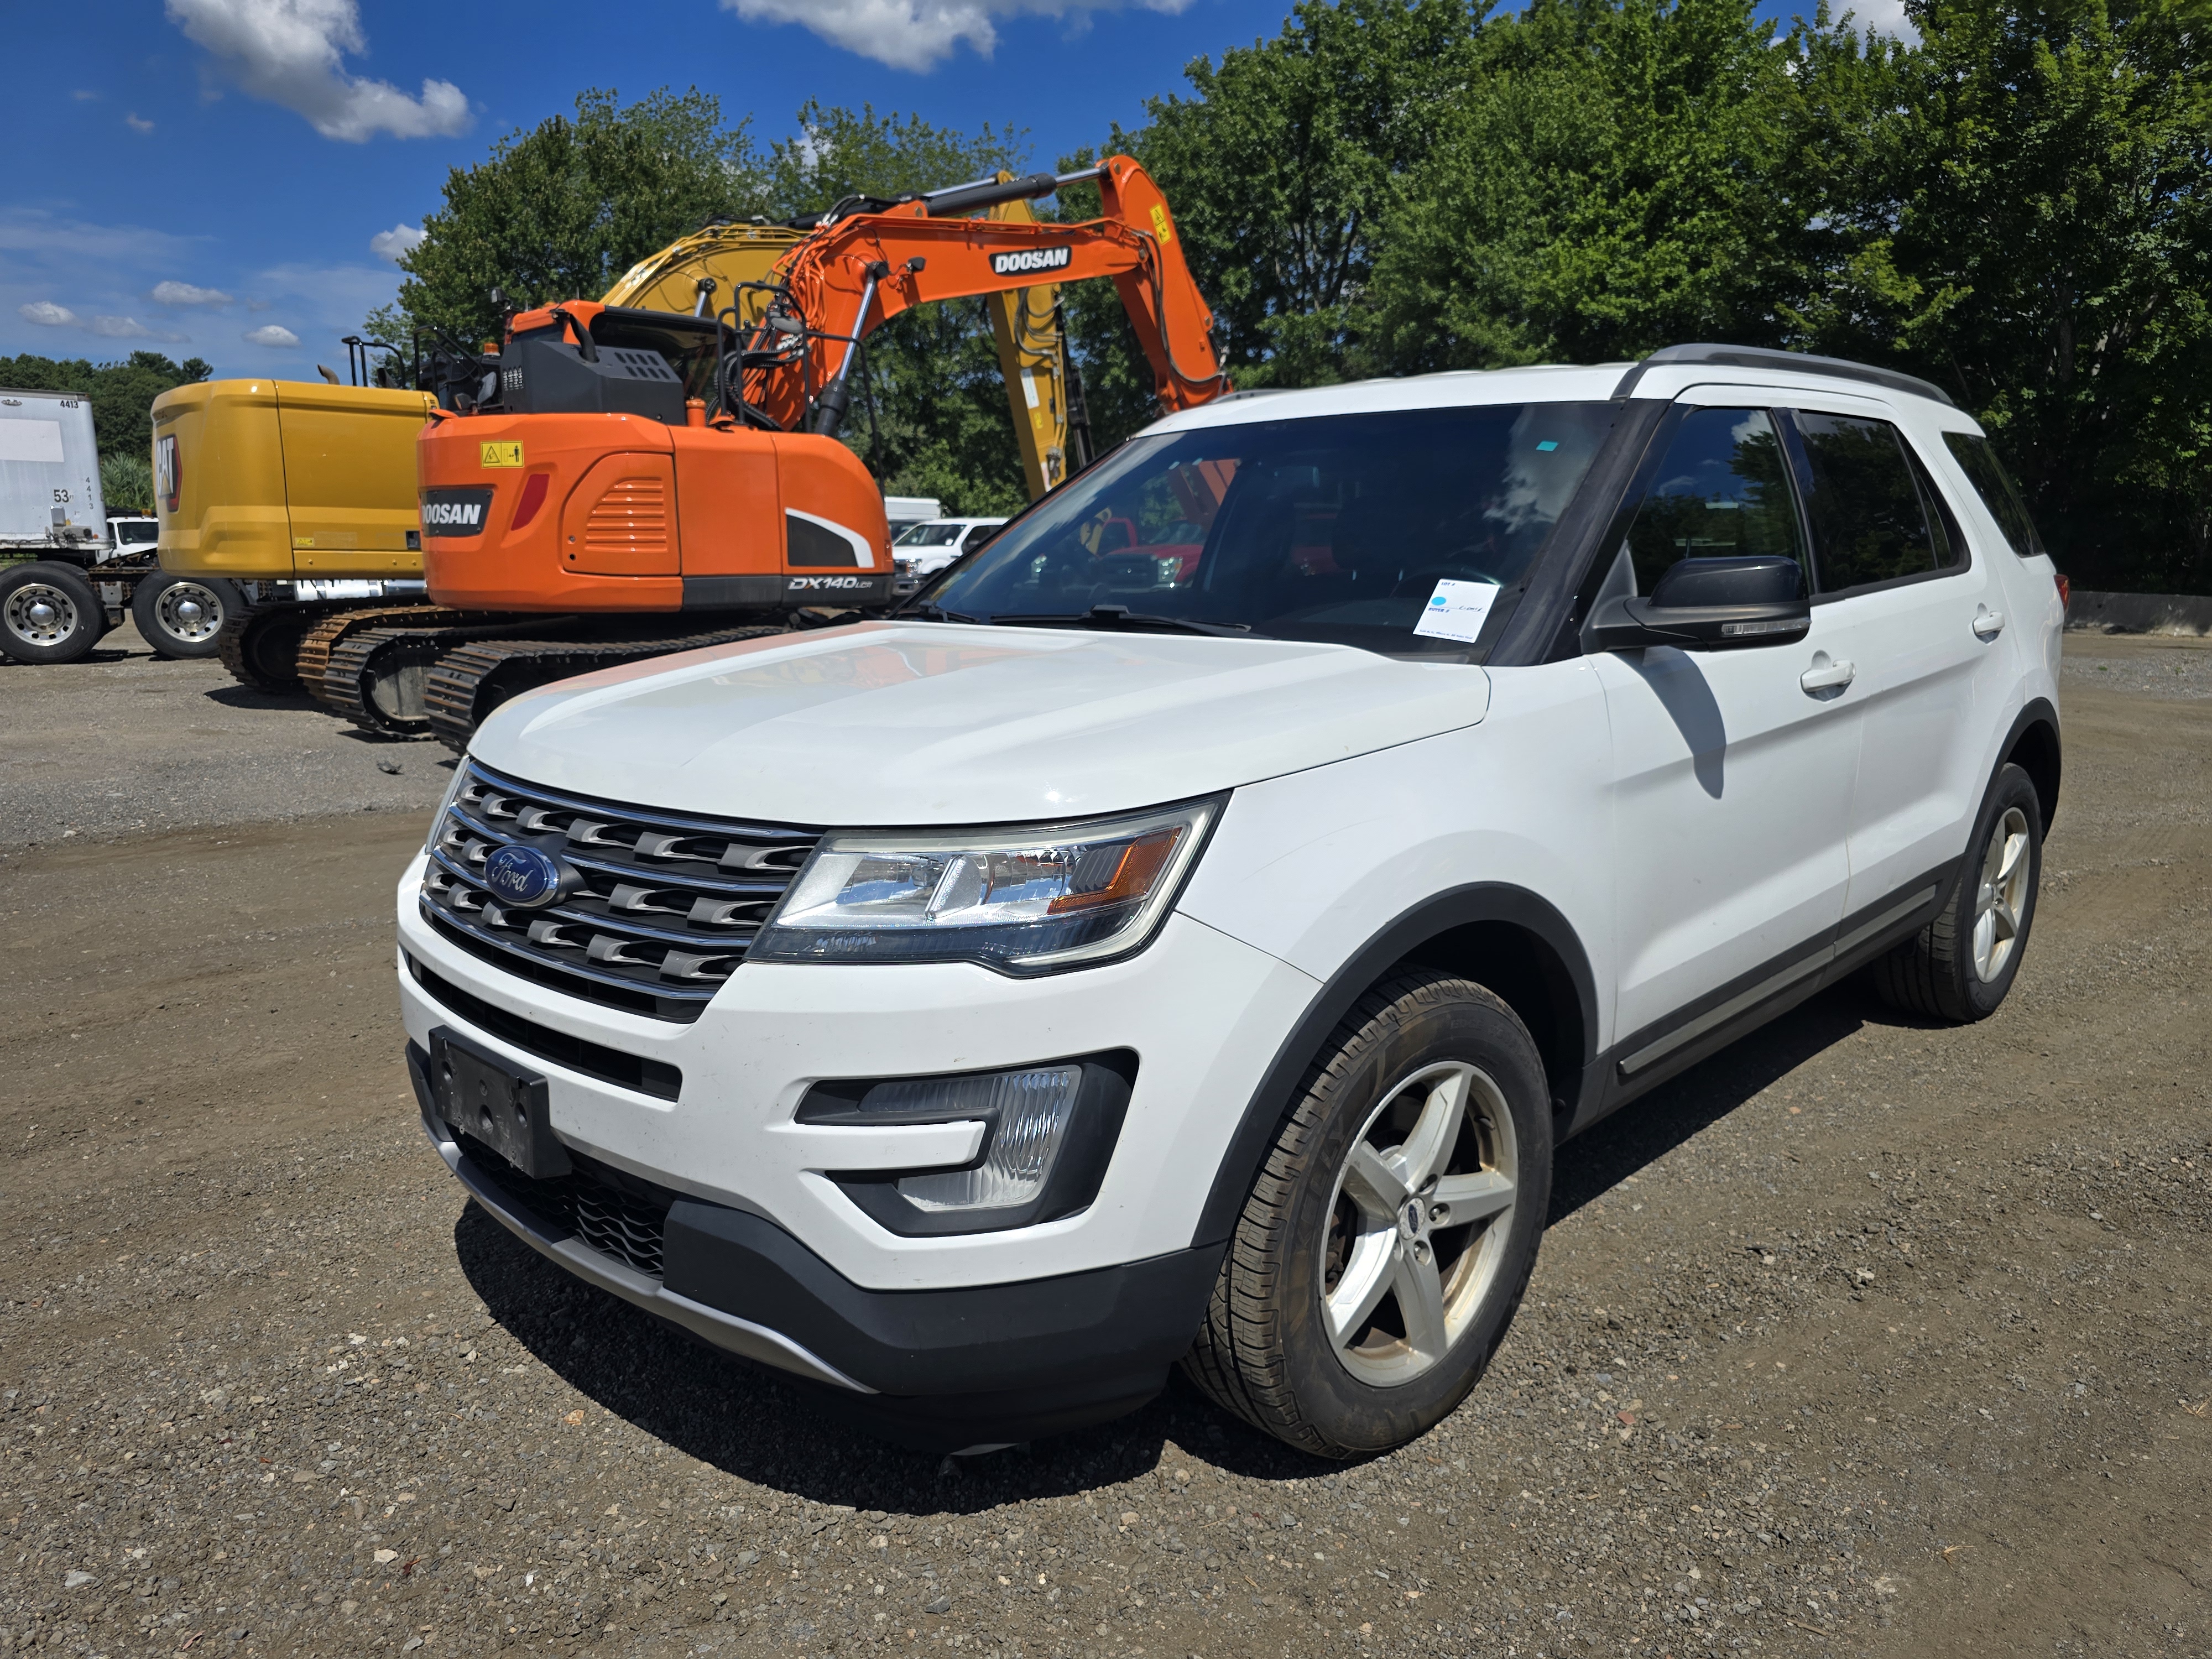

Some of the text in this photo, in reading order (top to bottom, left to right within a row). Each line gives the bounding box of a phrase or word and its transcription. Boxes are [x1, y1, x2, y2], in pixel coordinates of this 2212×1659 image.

[995, 248, 1068, 273] DOOSAN
[60, 400, 79, 409] 4413
[157, 437, 174, 496] CAT
[54, 489, 69, 503] 53
[422, 503, 481, 524] DOOSAN
[491, 852, 534, 892] Ford
